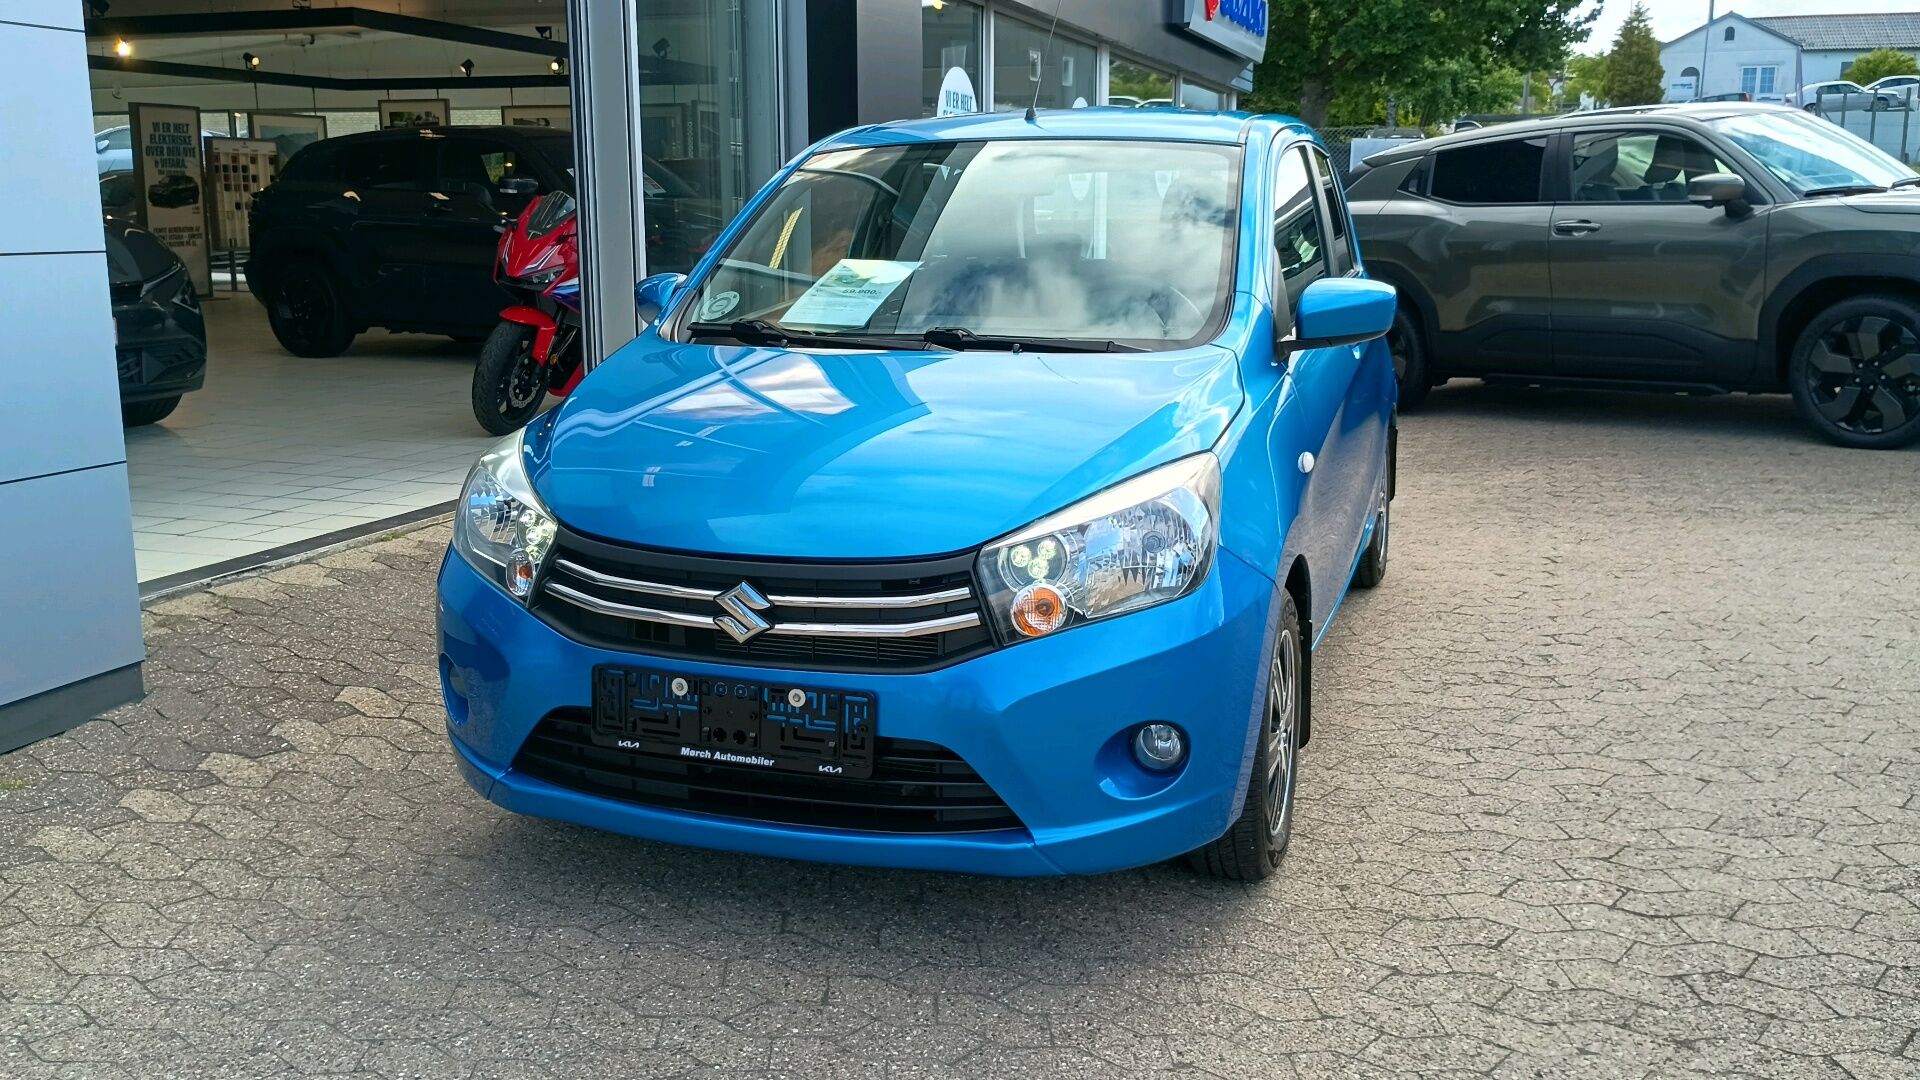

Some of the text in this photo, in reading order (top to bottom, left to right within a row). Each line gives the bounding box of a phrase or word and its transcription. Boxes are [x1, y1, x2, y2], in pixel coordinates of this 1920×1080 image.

[945, 90, 973, 112] VI ER HELT
[152, 122, 189, 134] VI ER HELT
[149, 134, 192, 145] ELEKTRISKE
[145, 145, 165, 157] OVER
[166, 146, 181, 157] DEN
[713, 752, 775, 766] Automobiler
